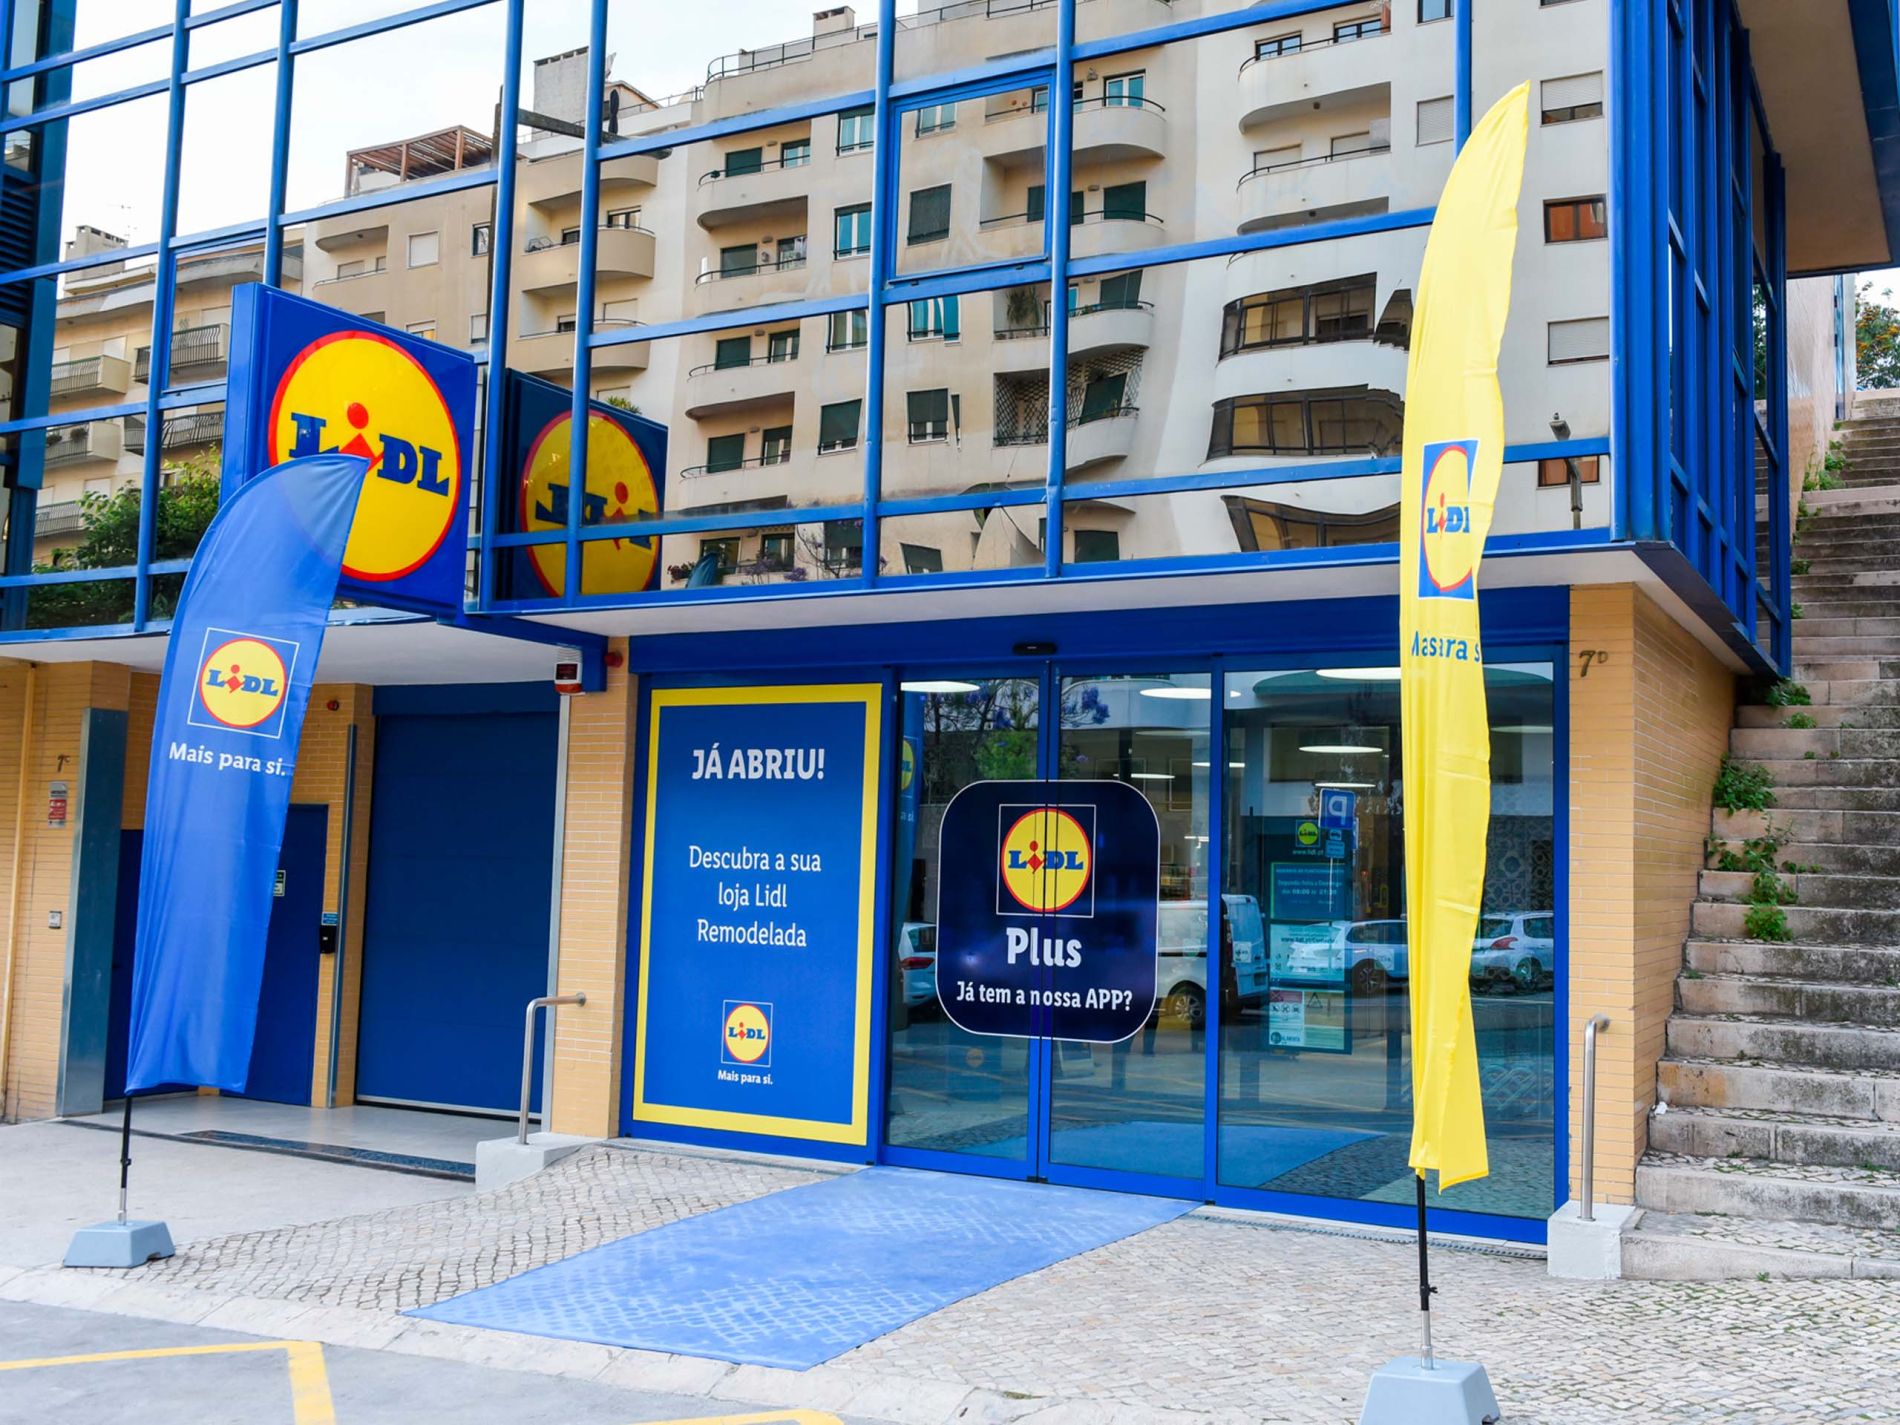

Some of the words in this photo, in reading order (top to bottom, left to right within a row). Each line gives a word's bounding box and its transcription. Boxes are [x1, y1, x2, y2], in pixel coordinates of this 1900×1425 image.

[169, 742, 214, 765] Mais
[218, 752, 261, 771] para
[265, 758, 286, 776] si.
[692, 742, 723, 780] JÁ
[727, 748, 825, 780] ABRIU!
[689, 845, 770, 871] Descubra
[775, 853, 785, 871] a
[790, 853, 822, 872] sua
[718, 881, 750, 912] loja
[755, 883, 788, 908] Lidl
[697, 918, 807, 947] Remodelada
[1006, 927, 1082, 968] Plus
[956, 981, 975, 1002] Já
[979, 984, 1011, 1004] tem
[1015, 989, 1026, 1005] a
[1030, 989, 1081, 1008] nossa
[1085, 988, 1133, 1012] APP?
[717, 1069, 739, 1082] Mais
[740, 1073, 761, 1085] para
[762, 1073, 774, 1085] si.
